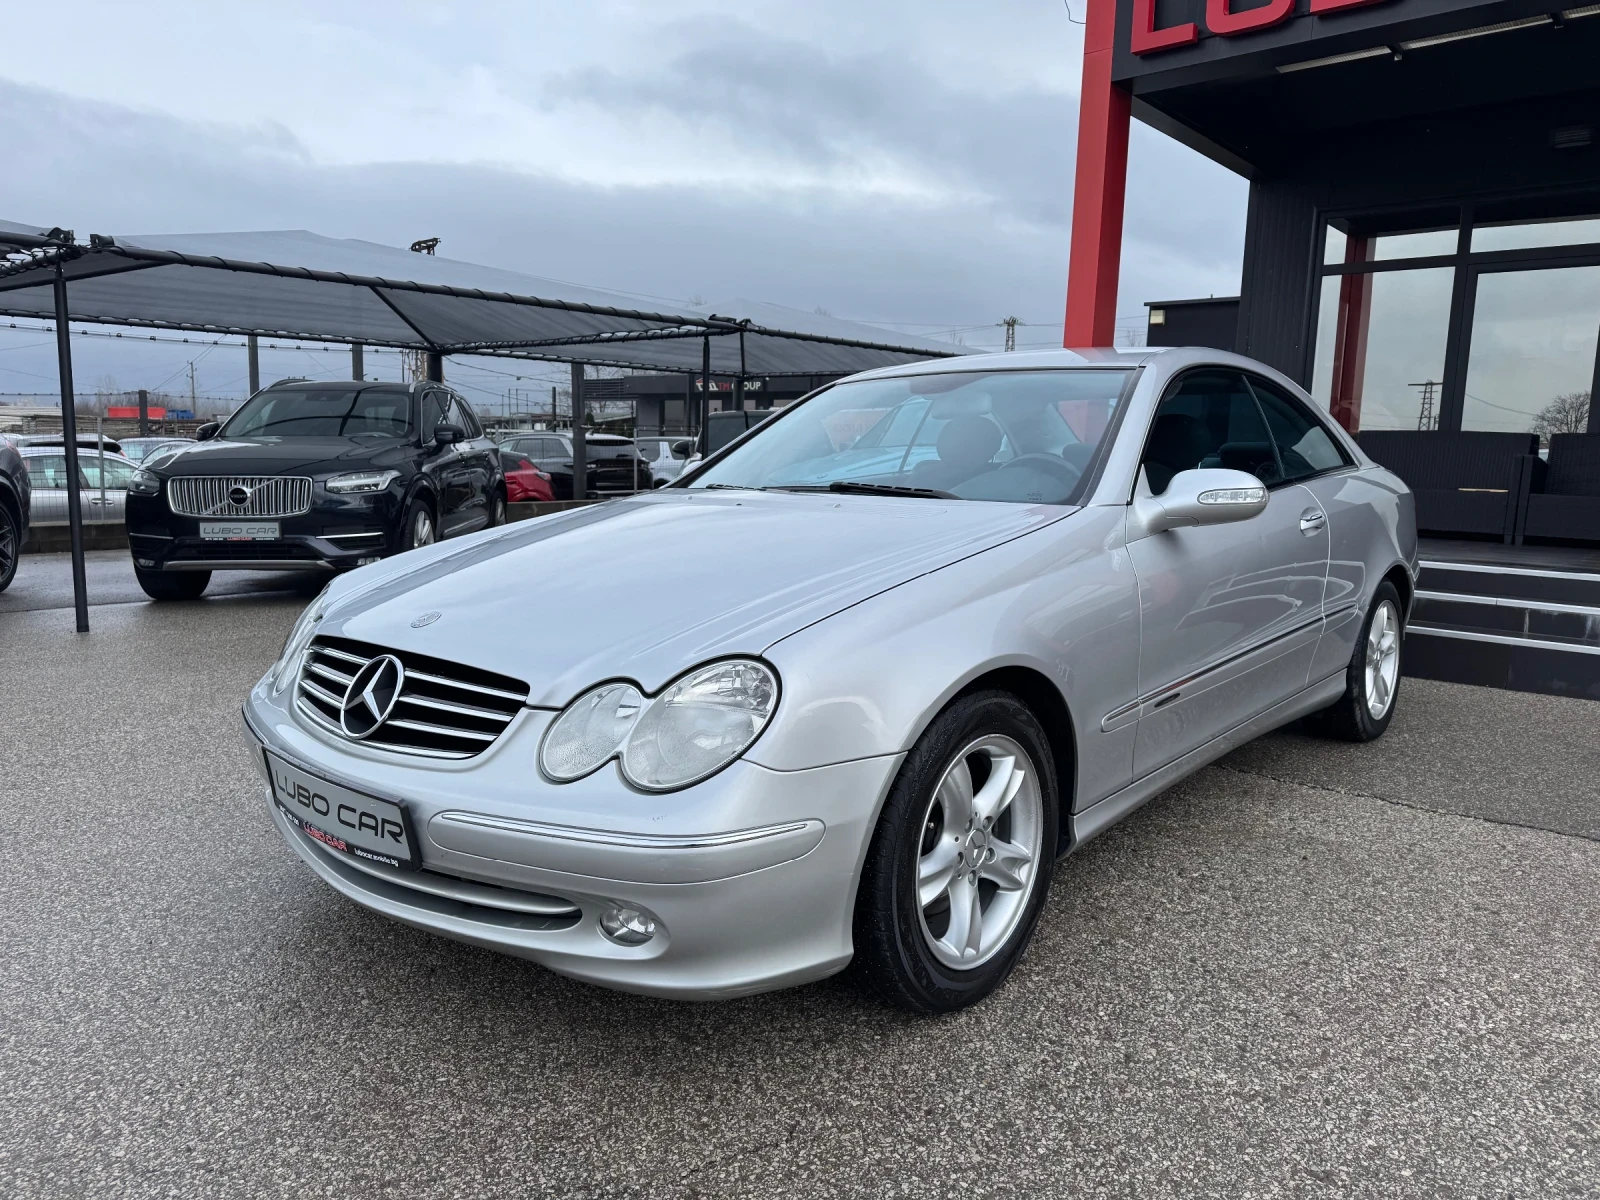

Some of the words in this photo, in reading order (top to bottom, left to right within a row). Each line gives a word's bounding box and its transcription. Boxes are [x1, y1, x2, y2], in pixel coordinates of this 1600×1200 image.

[203, 527, 243, 535] LUBO
[246, 527, 278, 535] CAR
[274, 769, 330, 817] LUBO
[337, 803, 404, 844] CAR
[303, 821, 326, 843] LUBO
[326, 834, 348, 852] CAR
